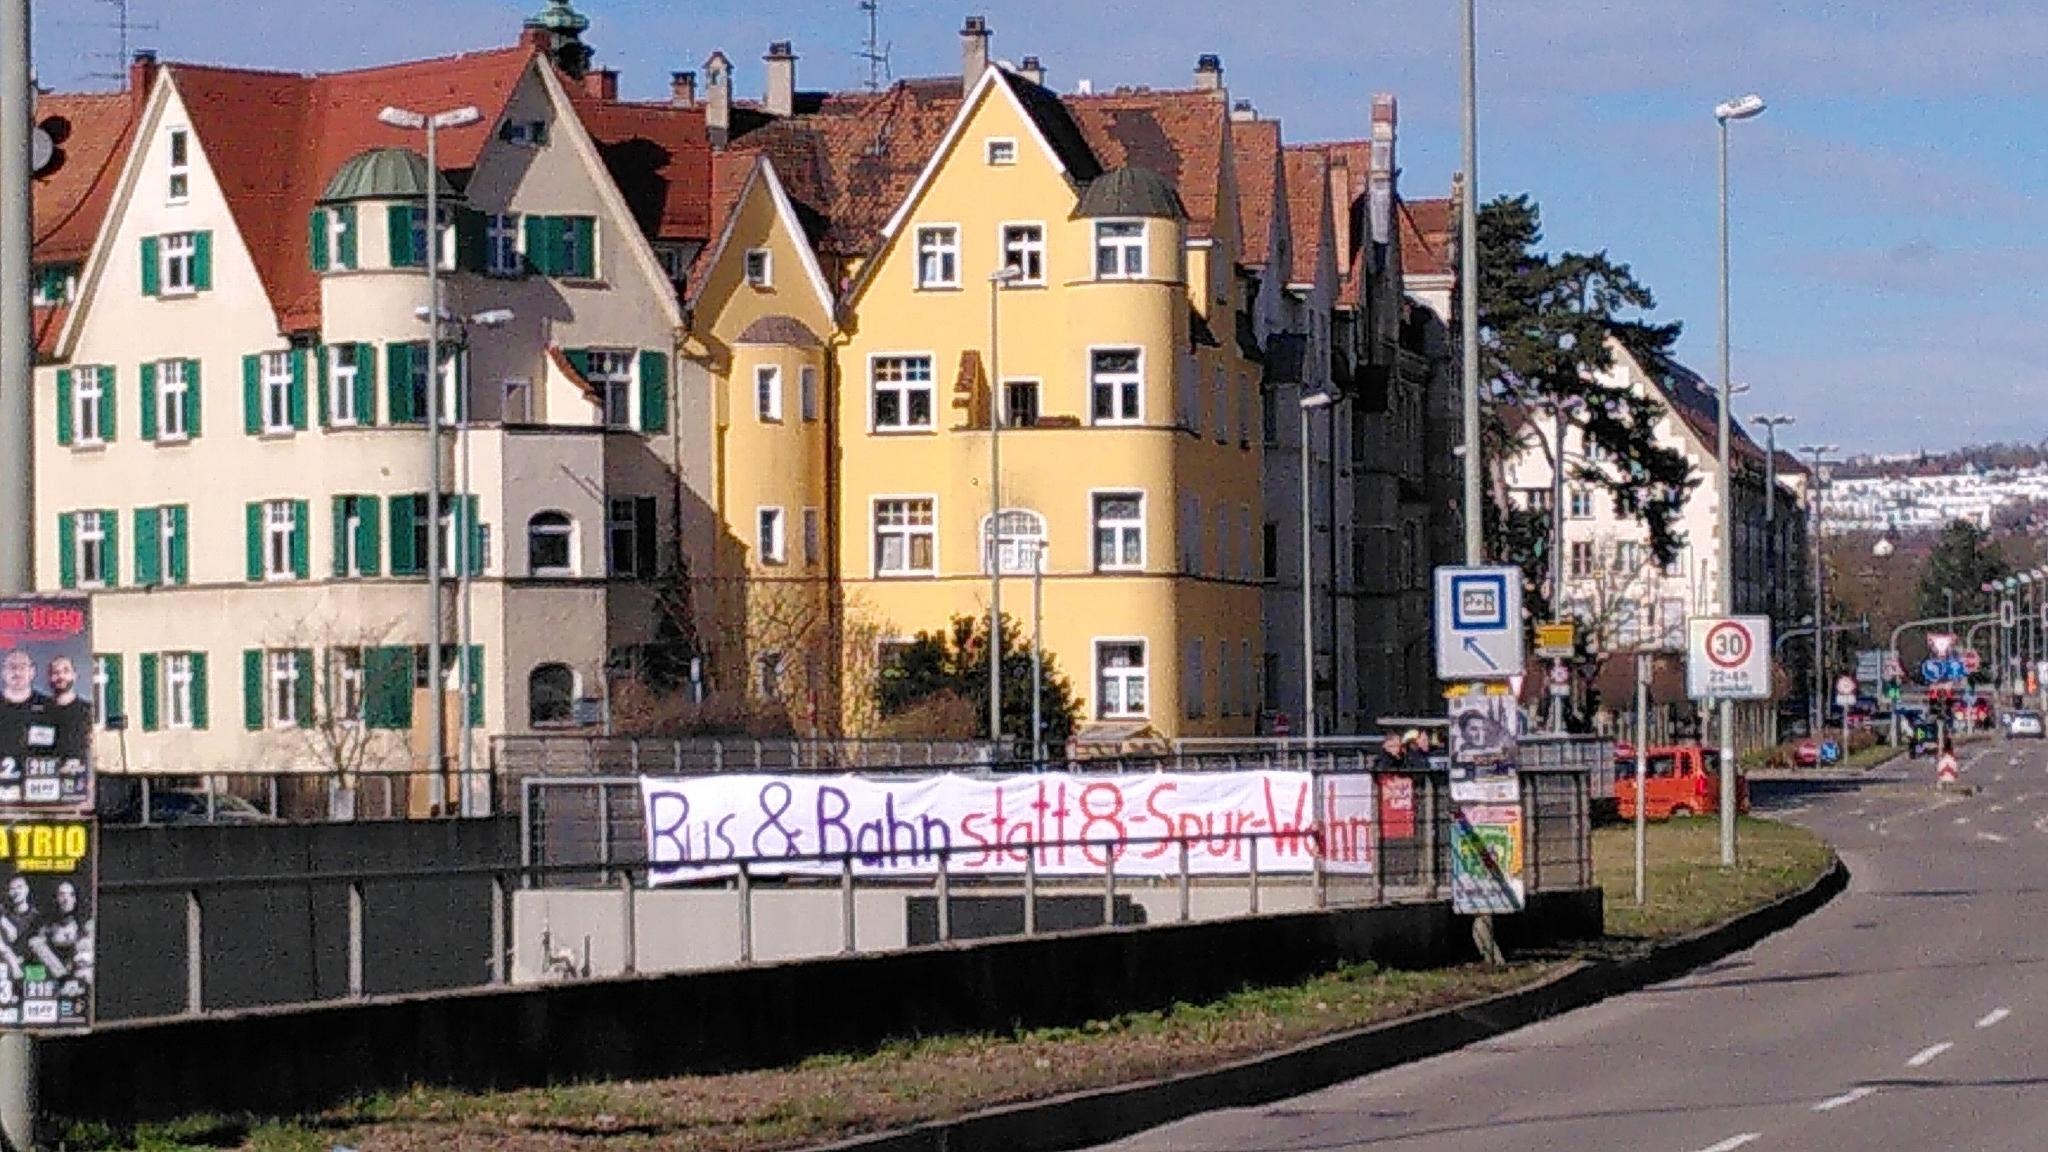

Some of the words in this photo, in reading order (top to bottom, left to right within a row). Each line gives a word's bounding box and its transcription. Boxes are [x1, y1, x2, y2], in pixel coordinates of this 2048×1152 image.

[1716, 634, 1743, 655] 30
[650, 791, 737, 873] Bus
[753, 781, 803, 858] &
[817, 785, 950, 868] Bahn
[961, 780, 1070, 867] statt
